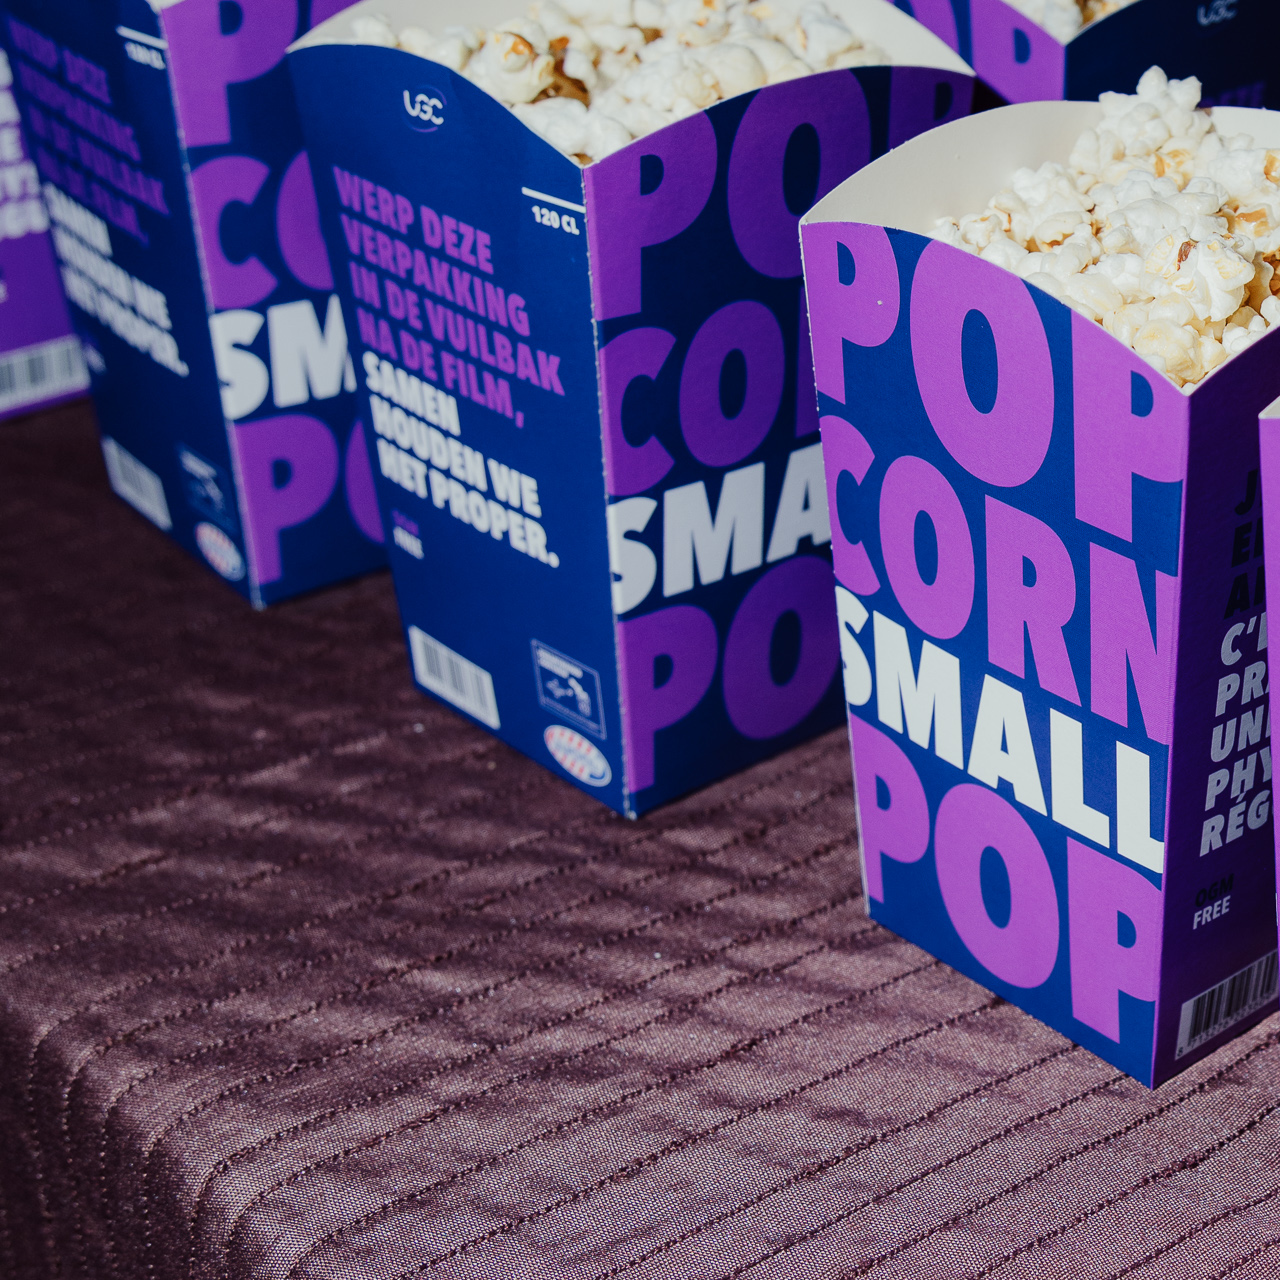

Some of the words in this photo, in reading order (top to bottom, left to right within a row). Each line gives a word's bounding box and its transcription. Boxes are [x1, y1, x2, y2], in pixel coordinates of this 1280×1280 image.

[403, 89, 444, 126] UGC
[333, 165, 414, 230] WERP
[421, 206, 494, 274] DEZE
[340, 213, 530, 336] VERPAKKING
[531, 205, 560, 229] 120
[561, 214, 580, 236] CL
[349, 261, 379, 306] IN
[387, 280, 419, 329] DE
[425, 297, 565, 396] VUILBAK
[359, 310, 397, 363] NA
[402, 335, 436, 383] DE
[442, 353, 524, 428] FILM,
[801, 221, 1187, 542] POP
[362, 350, 461, 435] SAMEN
[369, 395, 487, 491] HOUDEN
[488, 458, 542, 518] WE
[376, 438, 428, 499] HET
[429, 469, 560, 568] PROPER.
[818, 415, 1180, 746] CORN
[836, 585, 1166, 874] SMALL
[851, 714, 1164, 1044] POP
[1193, 895, 1231, 930] FREE
[1194, 873, 1235, 907] OGM
